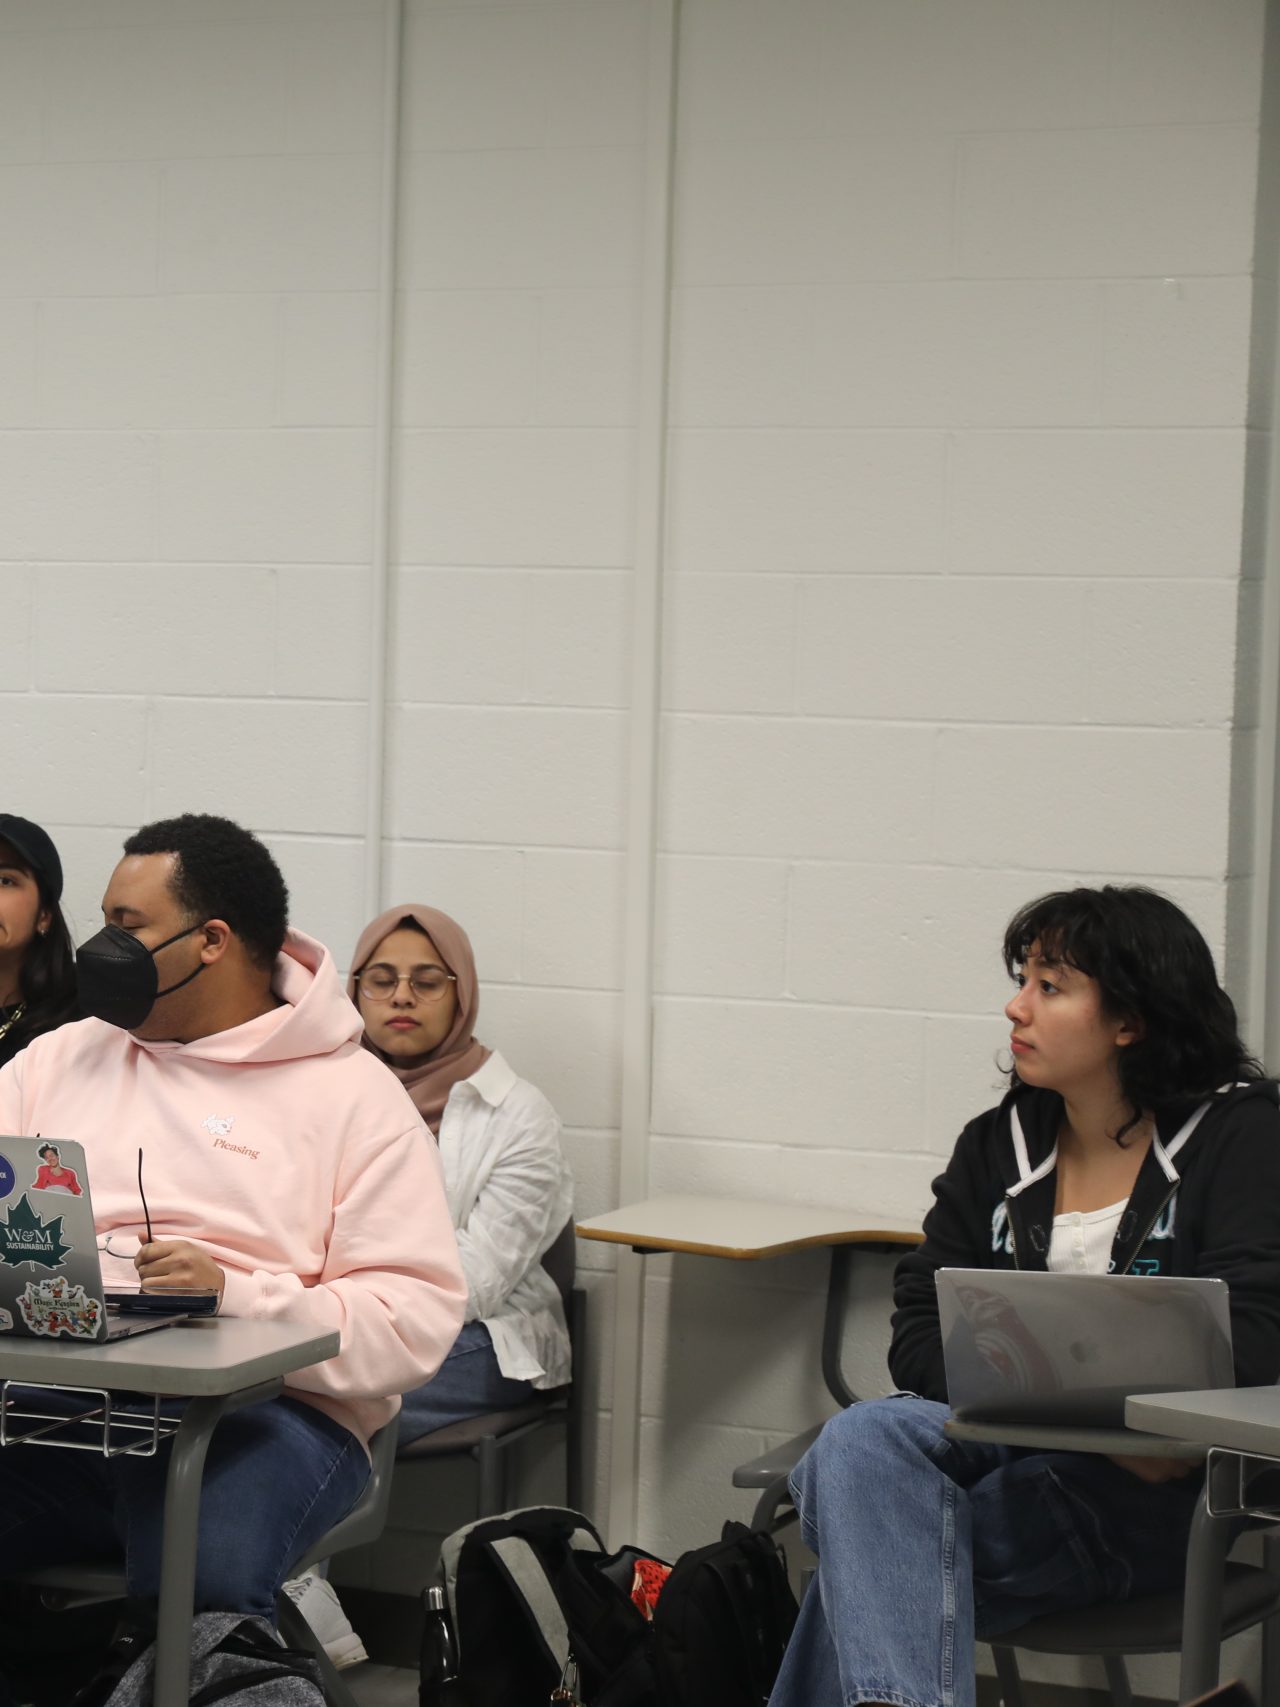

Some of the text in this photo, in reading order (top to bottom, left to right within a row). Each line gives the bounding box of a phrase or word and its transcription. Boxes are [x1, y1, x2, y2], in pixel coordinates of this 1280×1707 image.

[213, 1138, 260, 1160] Pleasing
[3, 1227, 53, 1244] W&M
[6, 1242, 54, 1251] SUSTAINABILITY
